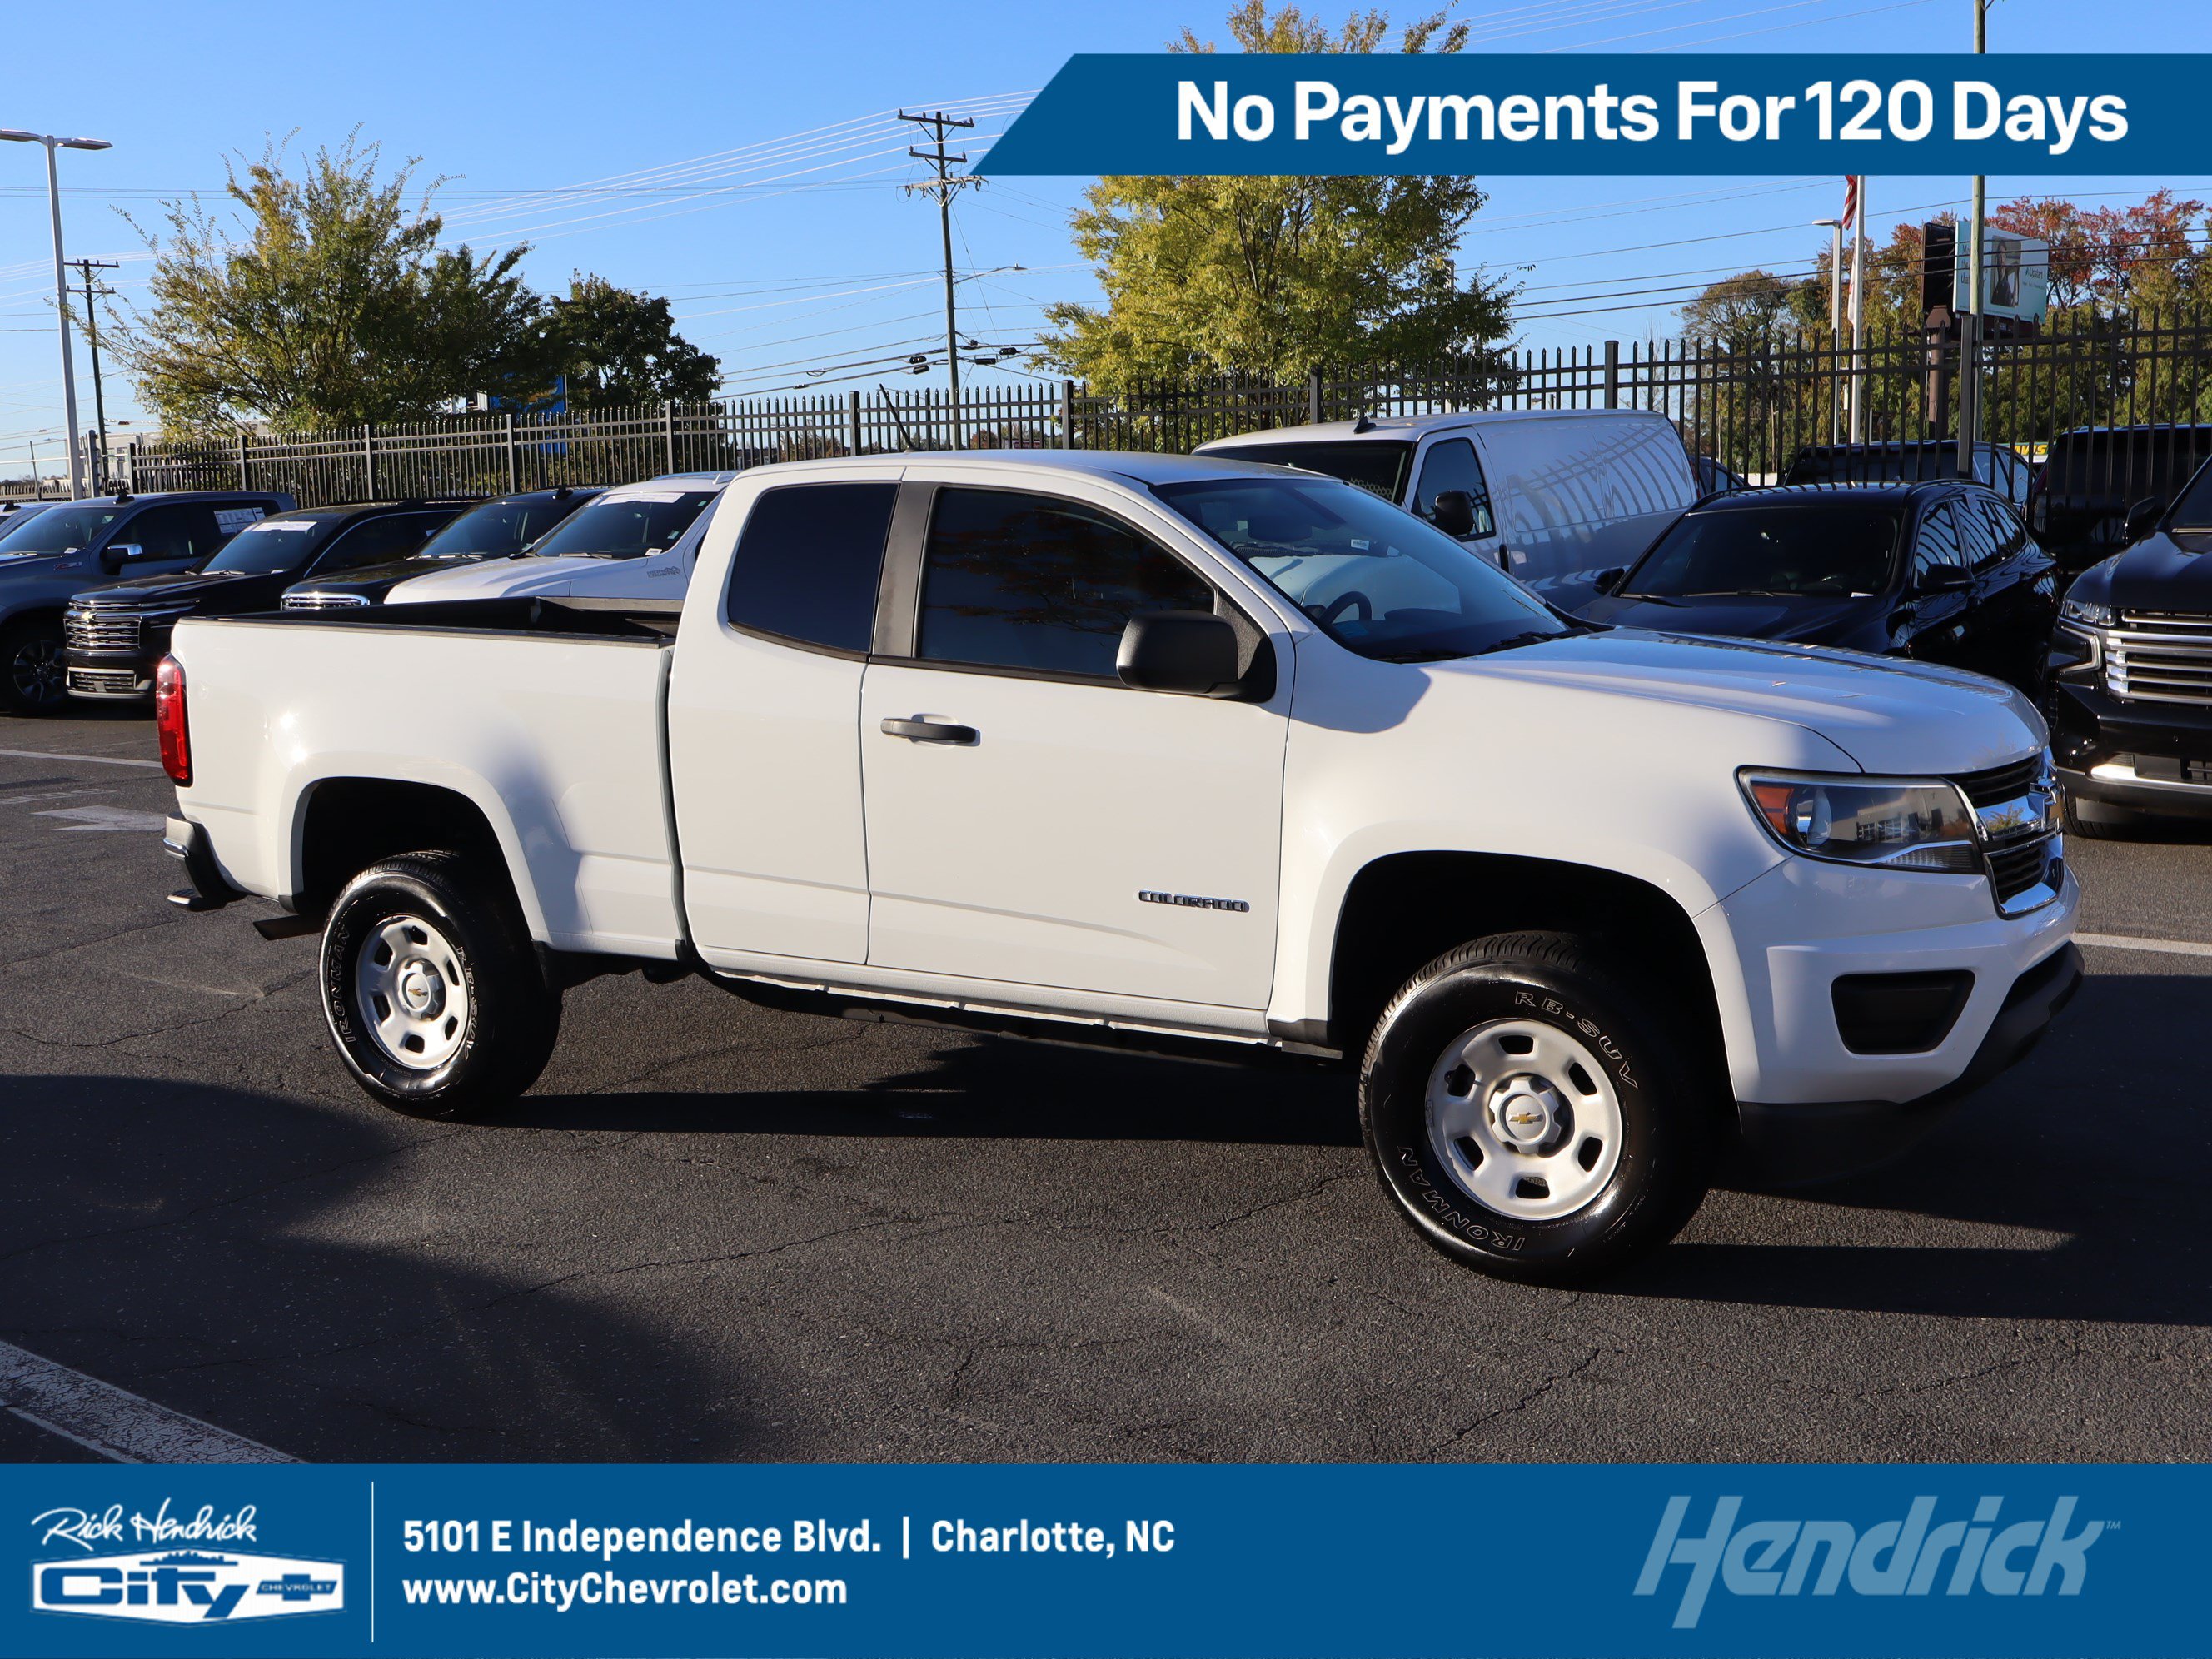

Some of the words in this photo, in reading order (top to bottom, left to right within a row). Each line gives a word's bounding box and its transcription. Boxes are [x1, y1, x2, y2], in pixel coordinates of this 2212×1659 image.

[1138, 889, 1250, 913] COLORADO
[1514, 990, 1638, 1089] RB-SUV
[1397, 1146, 1526, 1251] IRONMAN
